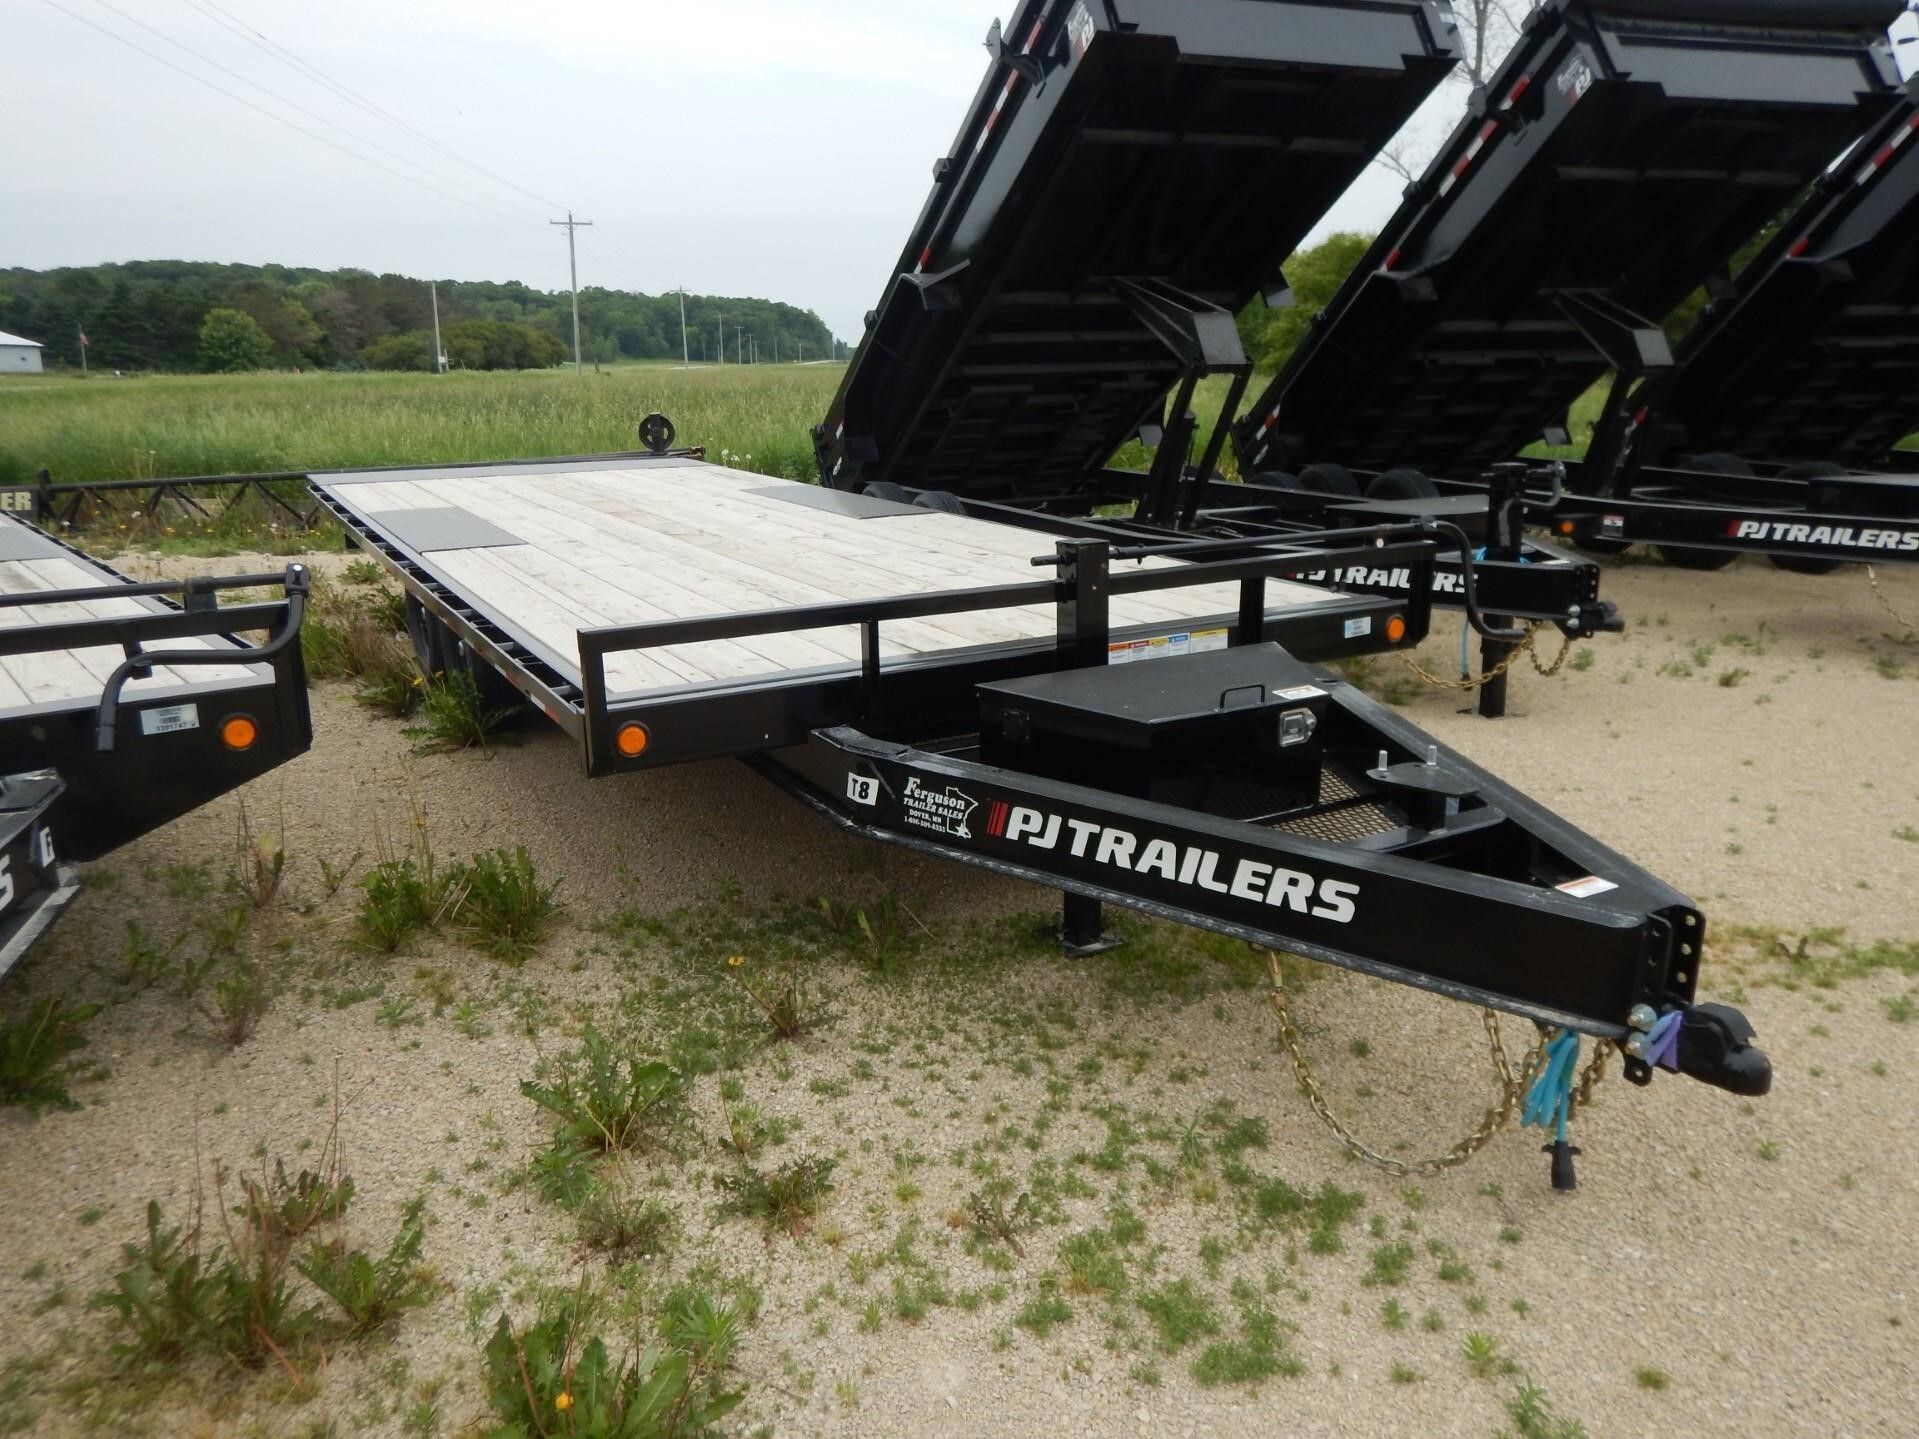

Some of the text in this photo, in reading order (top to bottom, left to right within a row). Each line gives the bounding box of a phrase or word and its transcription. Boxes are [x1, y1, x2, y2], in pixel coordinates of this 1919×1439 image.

[1736, 520, 1919, 551] PJ TRAILERS
[851, 777, 870, 801] T8
[903, 776, 966, 810] Ferguson
[903, 797, 964, 820] TRAILER SALES
[1005, 806, 1361, 924] PJ TRAILERS
